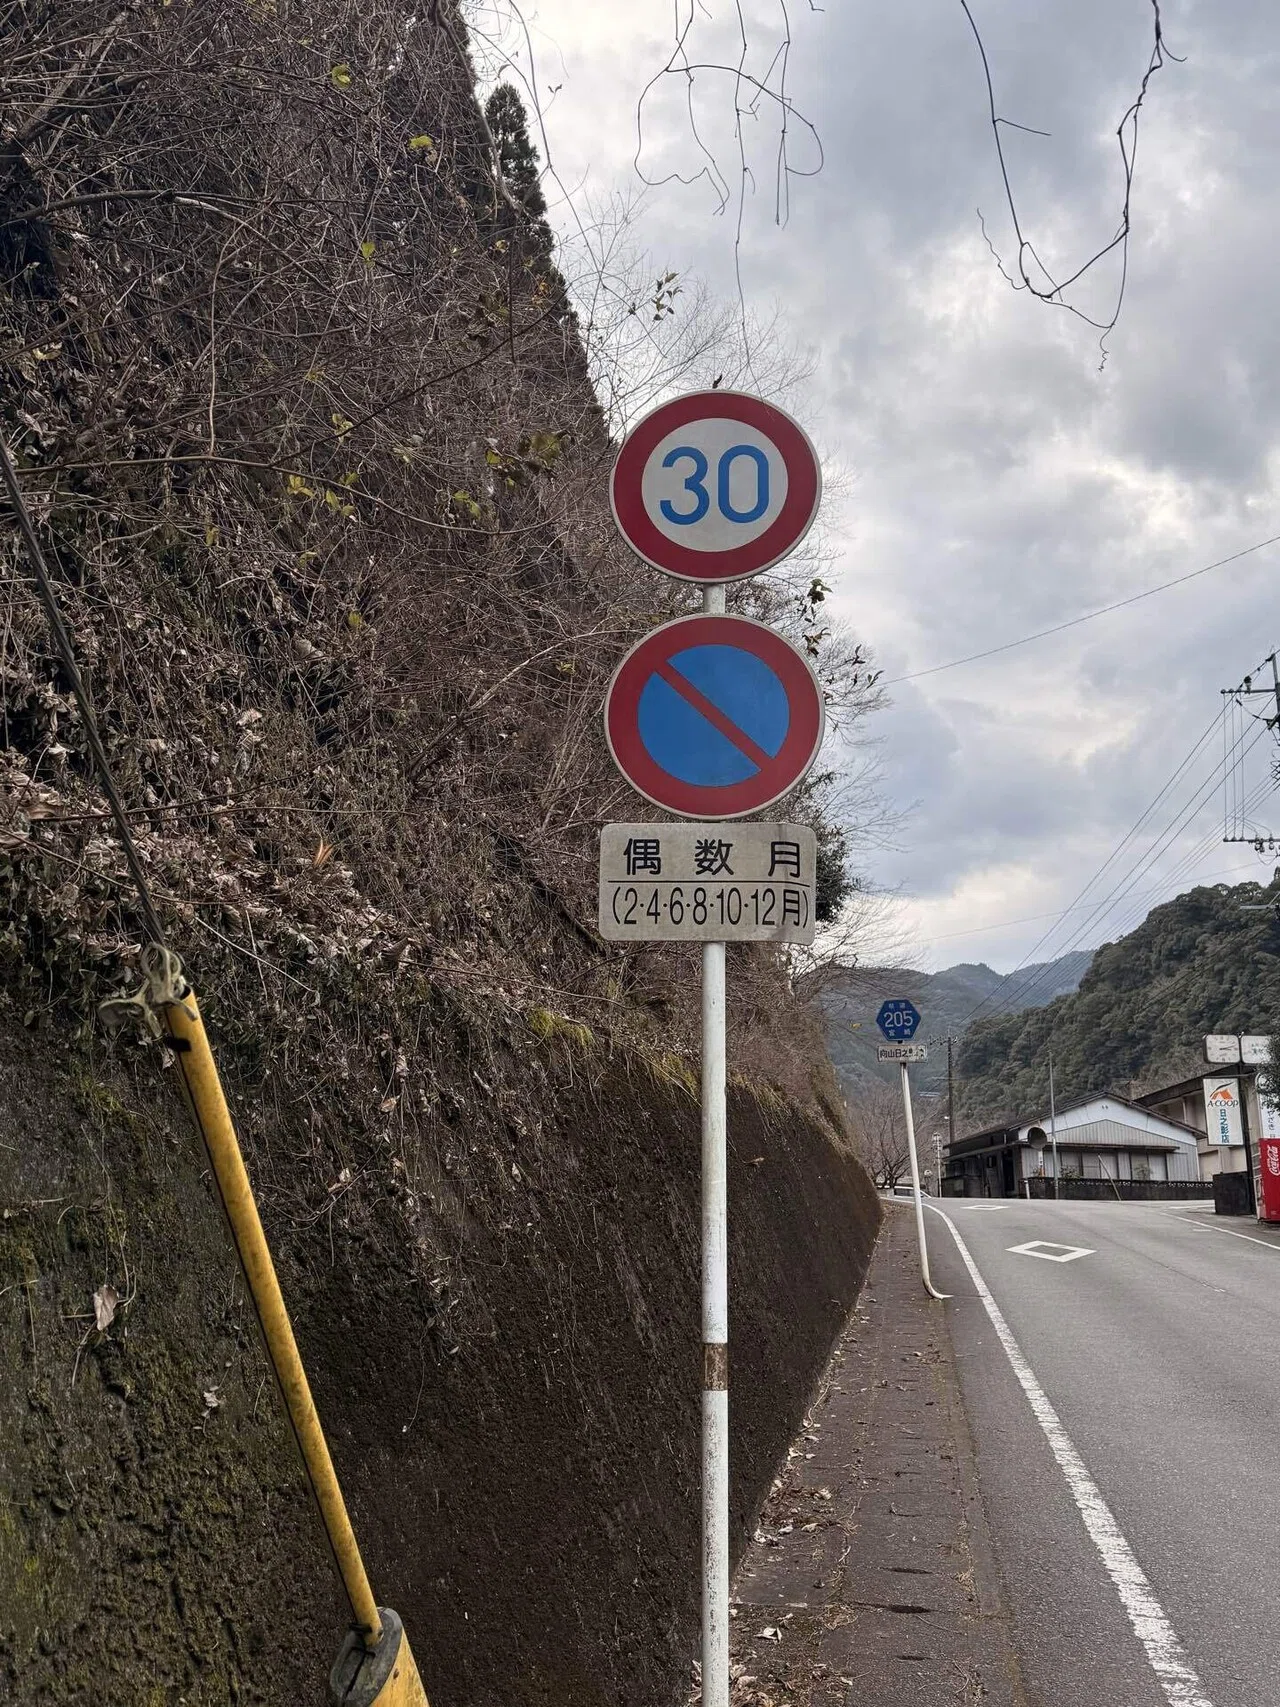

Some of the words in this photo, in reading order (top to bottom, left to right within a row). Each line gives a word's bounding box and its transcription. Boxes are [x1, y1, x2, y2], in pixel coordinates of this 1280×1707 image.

[660, 445, 769, 525] 30
[623, 838, 802, 877] 偶数月
[883, 1010, 913, 1027] 205
